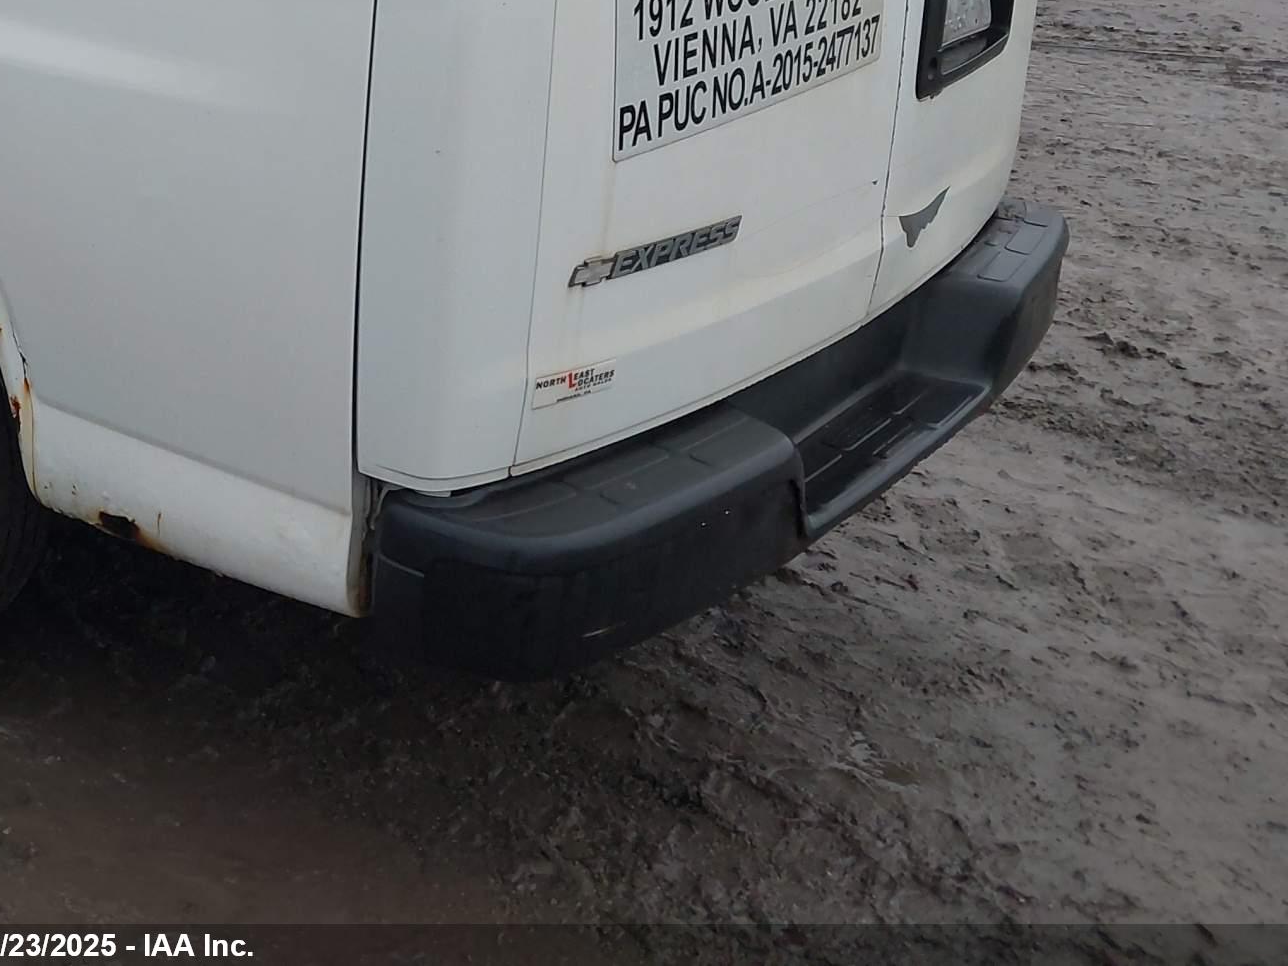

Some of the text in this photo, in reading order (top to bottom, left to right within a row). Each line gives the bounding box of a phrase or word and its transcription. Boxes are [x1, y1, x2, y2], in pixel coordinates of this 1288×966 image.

[654, 15, 763, 86] VIENNA,
[769, 0, 798, 47] VA
[618, 100, 652, 151] PA
[658, 80, 707, 138] PUC
[613, 219, 741, 277] EXPRESS
[535, 368, 595, 390] NORTH EAST
